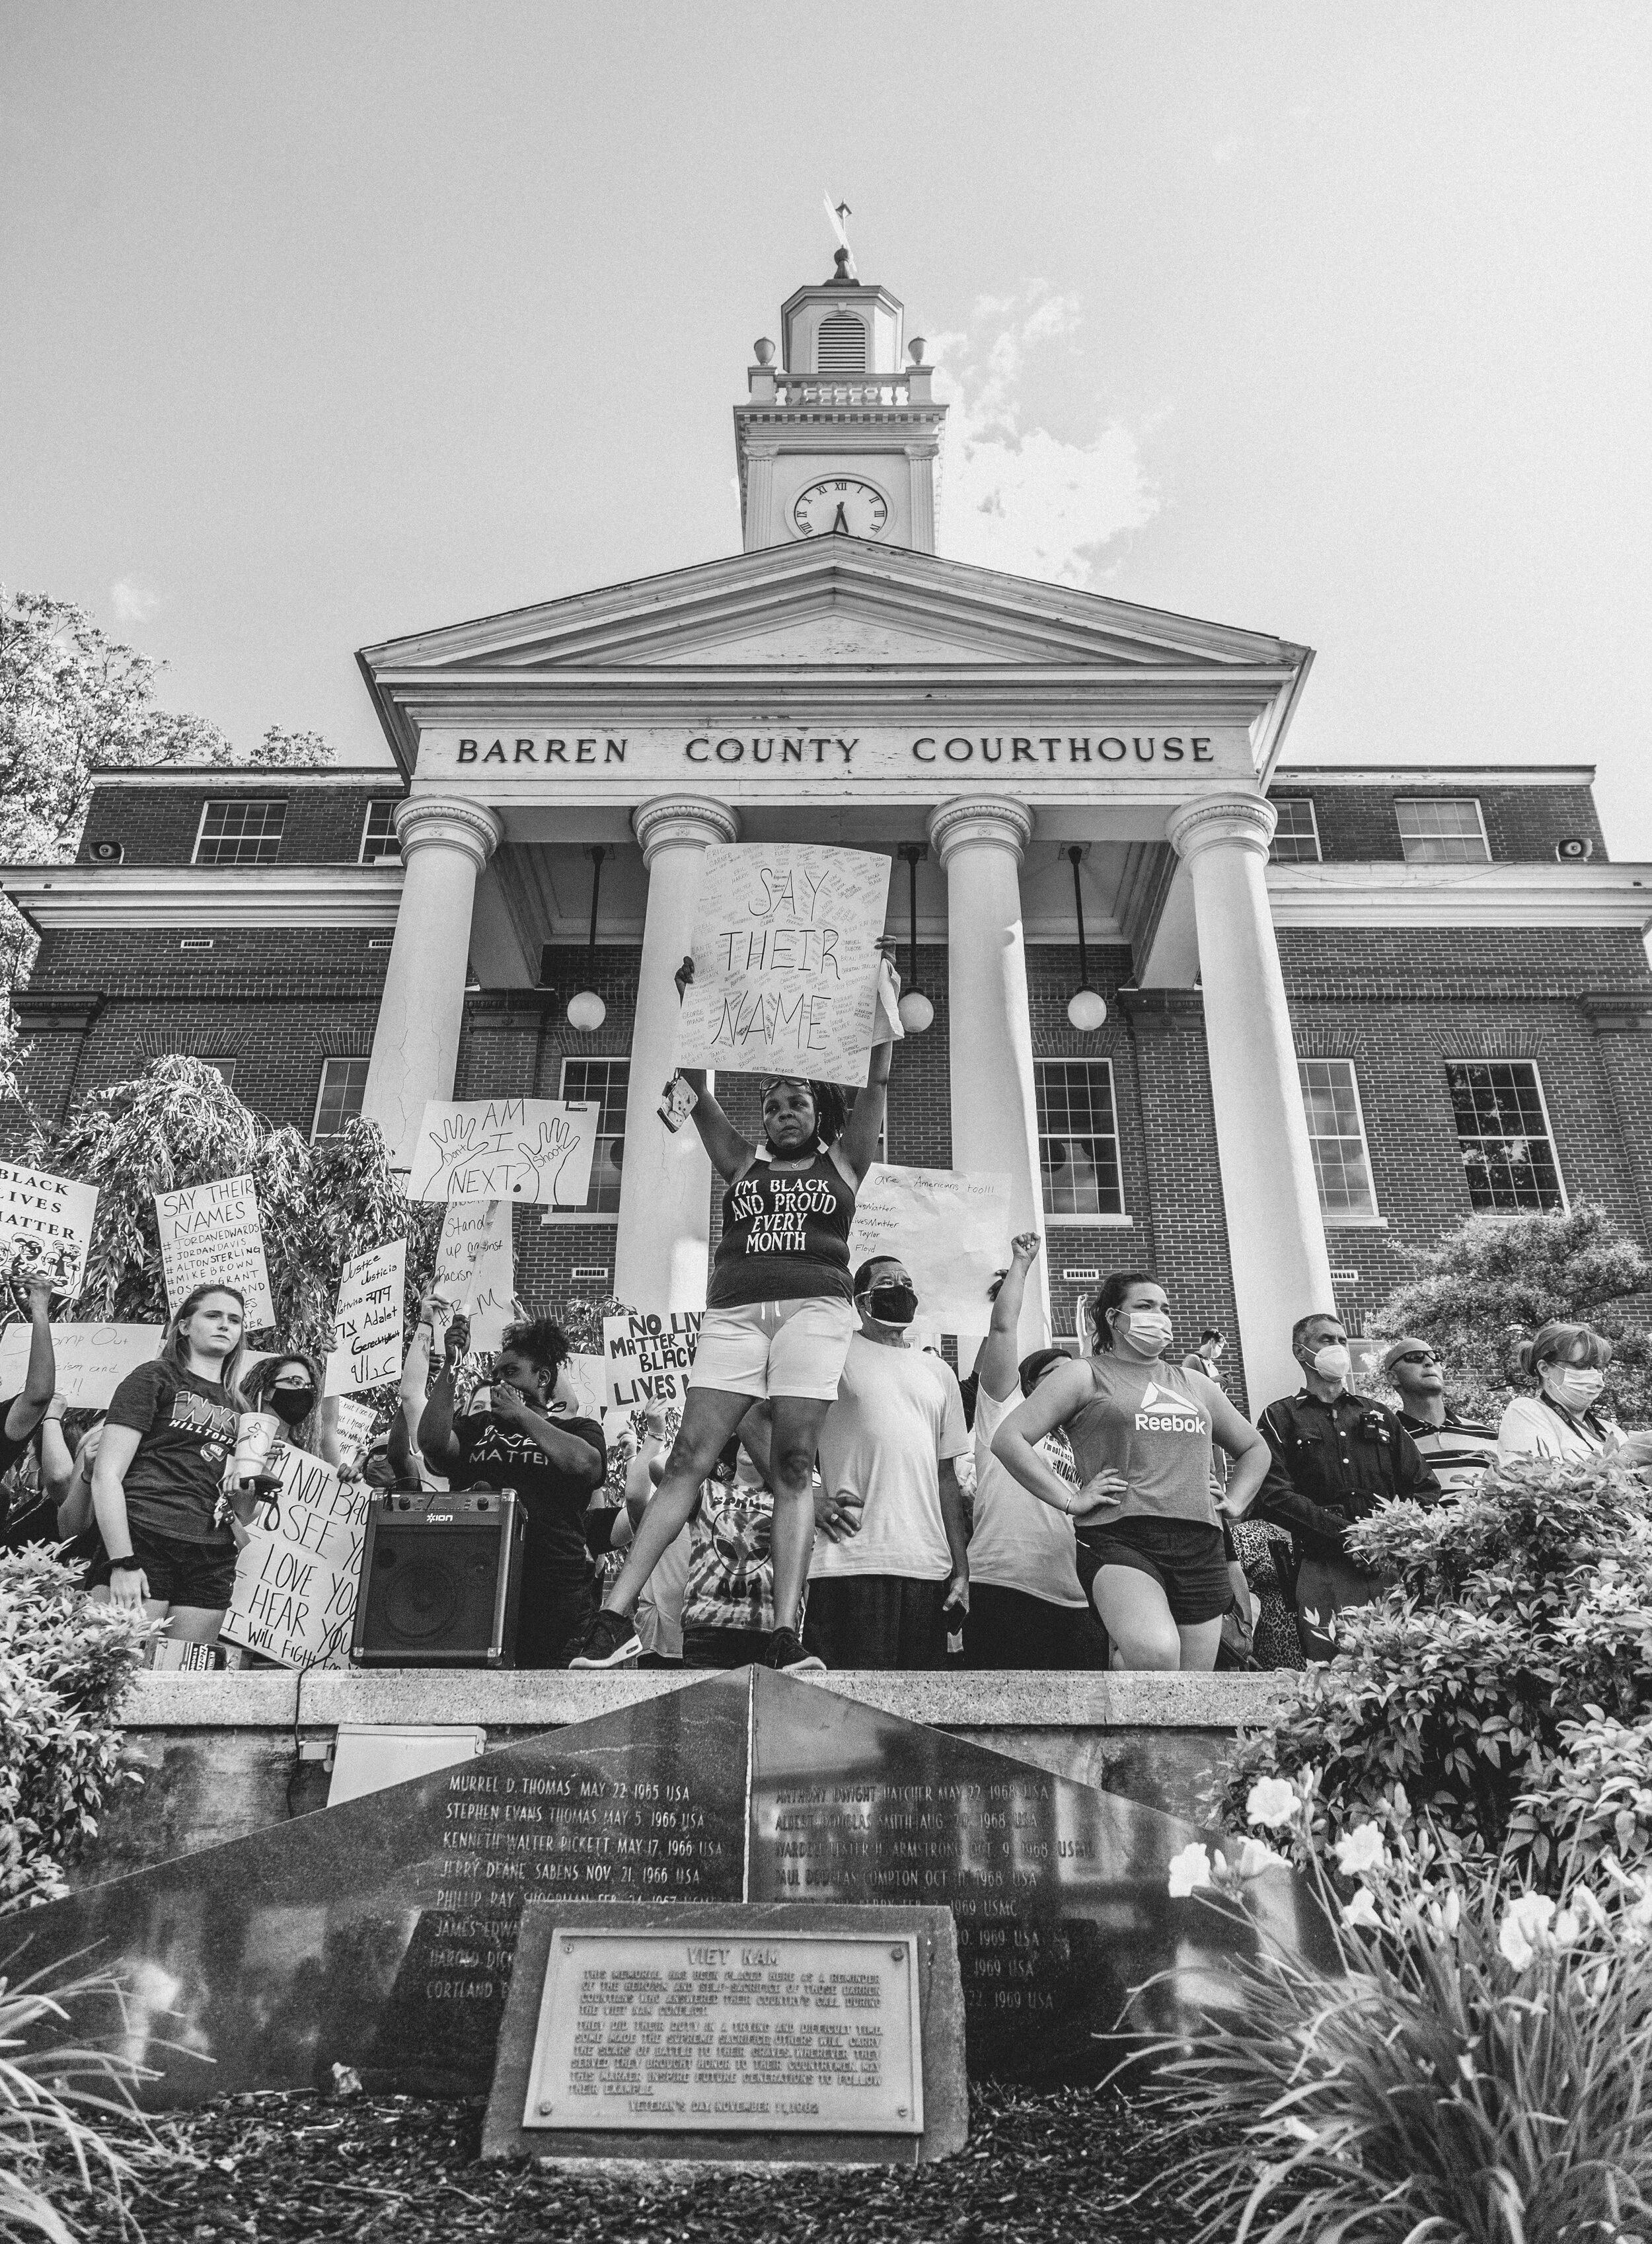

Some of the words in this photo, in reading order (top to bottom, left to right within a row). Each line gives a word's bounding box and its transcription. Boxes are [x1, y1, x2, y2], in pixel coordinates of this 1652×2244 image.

[457, 738, 628, 764] BARREN
[685, 737, 860, 764] COUNTY
[912, 737, 1215, 763] COURTHOUSE
[748, 868, 829, 922] SAY
[719, 929, 841, 981] THEIR
[710, 990, 832, 1051] NAME
[482, 1098, 525, 1130] AM
[482, 1132, 514, 1155] I
[533, 1144, 563, 1168] Shoot
[0, 1168, 69, 1196] BLACK
[452, 1163, 531, 1194] NEXT?
[735, 1179, 759, 1197] I'M
[770, 1178, 830, 1193] BLACK
[914, 1176, 959, 1190] Americans
[0, 1191, 61, 1213] IVES
[163, 1189, 196, 1217] SAY
[206, 1178, 254, 1203] THEIR
[732, 1194, 764, 1221] AND
[774, 1193, 837, 1215] PROUD
[174, 1201, 245, 1239] NAMES
[445, 1215, 484, 1237] Stand
[751, 1213, 808, 1233] EVERY
[745, 1232, 807, 1253] MONTH
[858, 1230, 880, 1240] Taylor
[446, 1243, 461, 1258] up
[855, 1244, 876, 1254] Floyd
[342, 1255, 381, 1283] Justice
[361, 1264, 397, 1285] Justicia
[363, 1306, 398, 1329] Adalet
[628, 1314, 662, 1338] NO
[92, 1327, 128, 1345] Out
[610, 1333, 679, 1360] MATTER
[614, 1374, 677, 1405] LIVES
[1135, 1413, 1206, 1435] Reebok
[287, 1459, 332, 1509] NOT
[283, 1505, 337, 1559] SEE
[342, 1531, 364, 1575] YO
[260, 1544, 318, 1596] LOVE
[221, 1610, 244, 1633] I
[248, 1585, 310, 1637] HEAR
[449, 1775, 499, 1793] MURREL
[522, 1777, 571, 1797] THOMAS
[580, 1781, 606, 1797] MAY
[666, 1785, 690, 1802] USA
[445, 1803, 500, 1821] STEPHEN
[505, 1805, 542, 1822] EVANS
[549, 1807, 596, 1824] THOMAS
[604, 1809, 628, 1826] MAY
[651, 1811, 677, 1828] 1966
[681, 1813, 704, 1829] USA
[443, 1831, 500, 1850] KENNETH
[506, 1833, 554, 1851] WALTER
[560, 1835, 611, 1853] PICKETT
[617, 1838, 643, 1855] MAY
[668, 1840, 693, 1857] 1966
[699, 1841, 722, 1857] USA
[439, 1859, 480, 1878] JERRY
[535, 1863, 578, 1881] SABENS
[642, 1866, 668, 1884] 1966
[676, 1867, 700, 1885] USA
[983, 1898, 1017, 1917] USMC
[1014, 1929, 1039, 1947] USA
[995, 1990, 1022, 2008] 1969
[1028, 1991, 1053, 2009] USA
